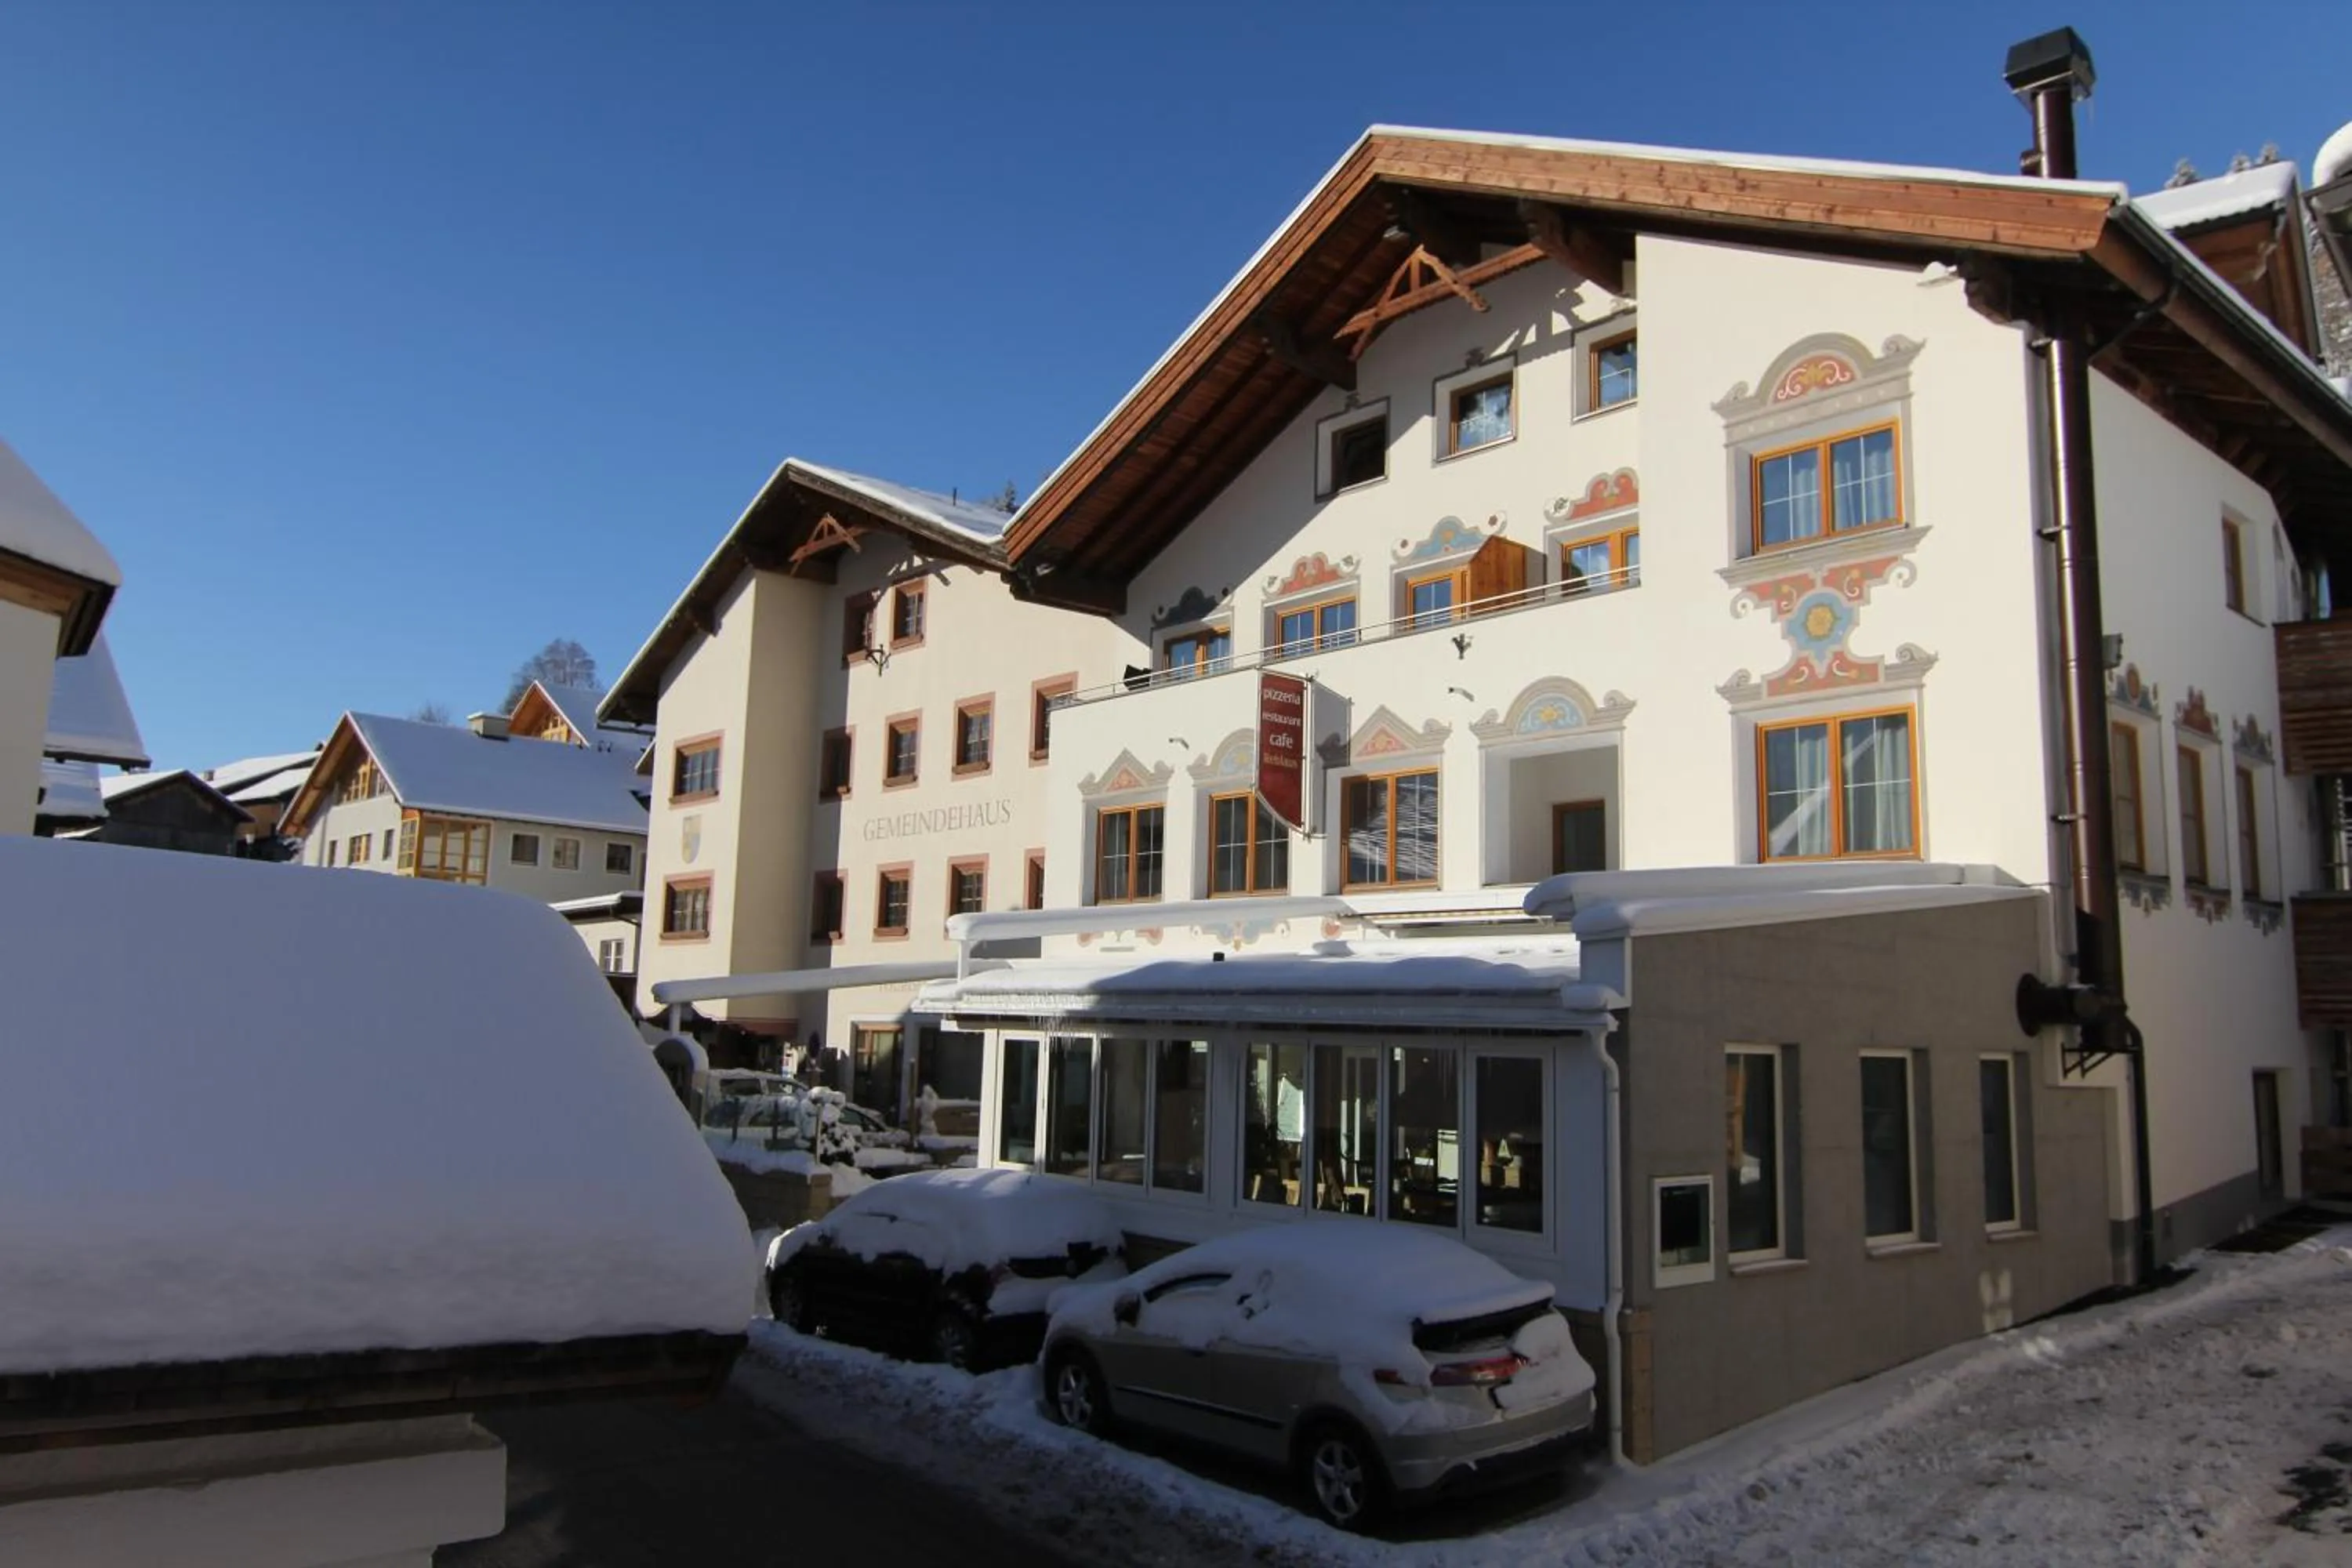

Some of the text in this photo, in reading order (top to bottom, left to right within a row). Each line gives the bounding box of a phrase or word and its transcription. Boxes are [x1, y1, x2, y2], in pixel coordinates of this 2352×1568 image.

[1263, 688, 1301, 706] pizzeria
[1261, 713, 1301, 727] restaurant
[1269, 733, 1294, 749] cafe
[863, 799, 1011, 841] GEMEINDEHAUS
